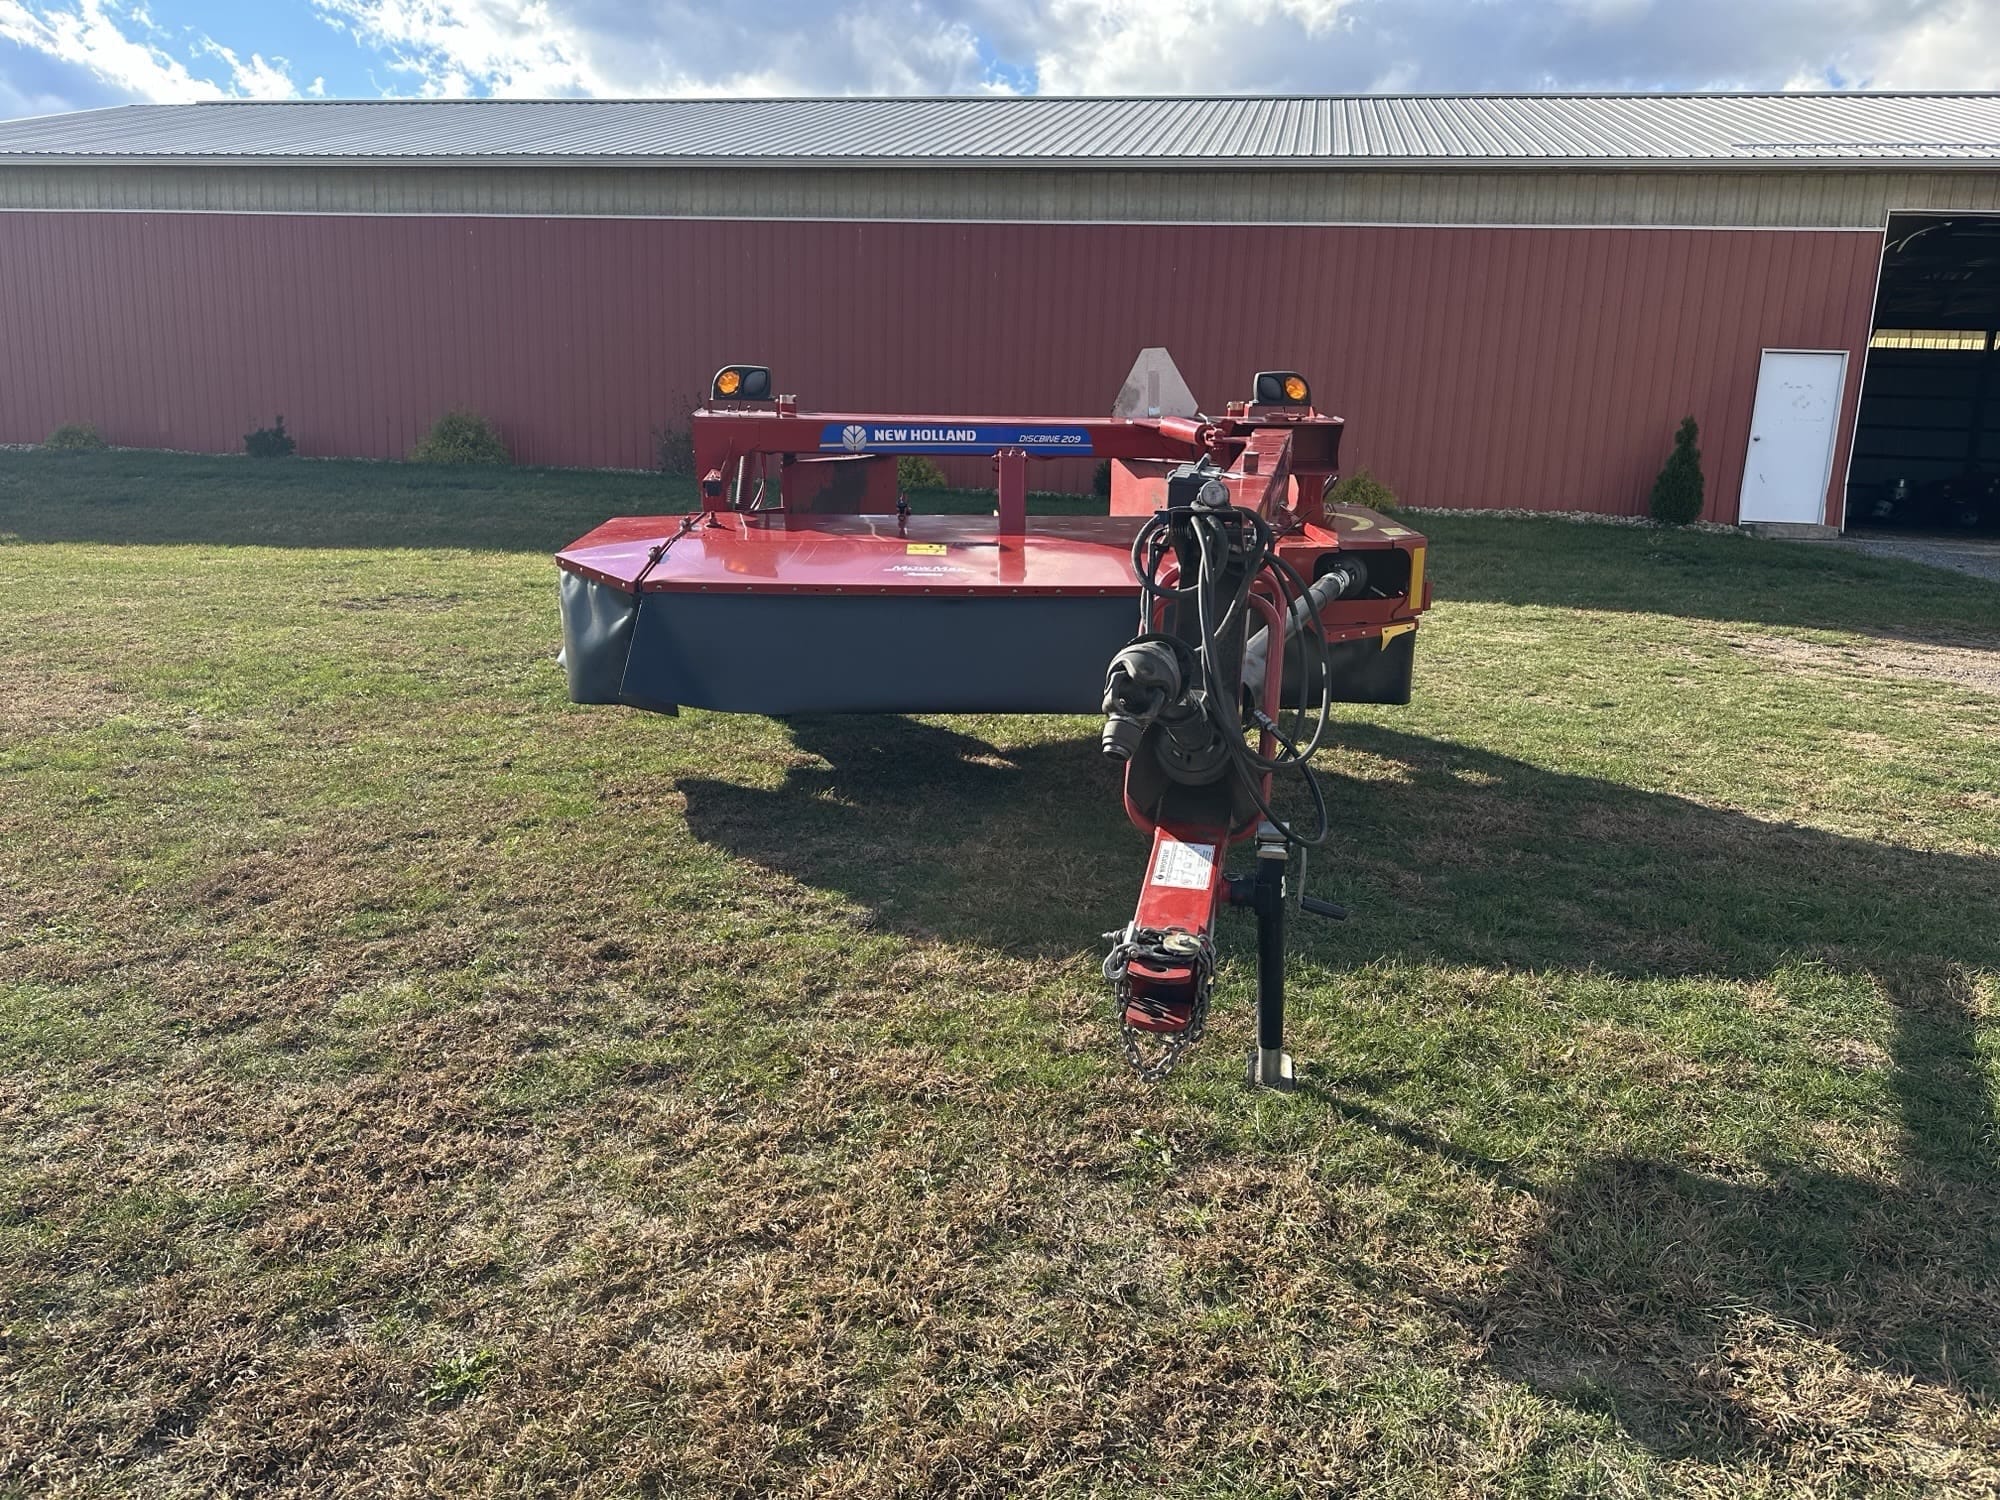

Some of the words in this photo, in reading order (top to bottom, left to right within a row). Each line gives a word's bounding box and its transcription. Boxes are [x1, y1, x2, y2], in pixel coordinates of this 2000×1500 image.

[874, 429, 907, 441] NEW
[910, 430, 977, 441] HOLLAND
[1018, 434, 1060, 443] DISCBINE
[1061, 435, 1081, 443] 209
